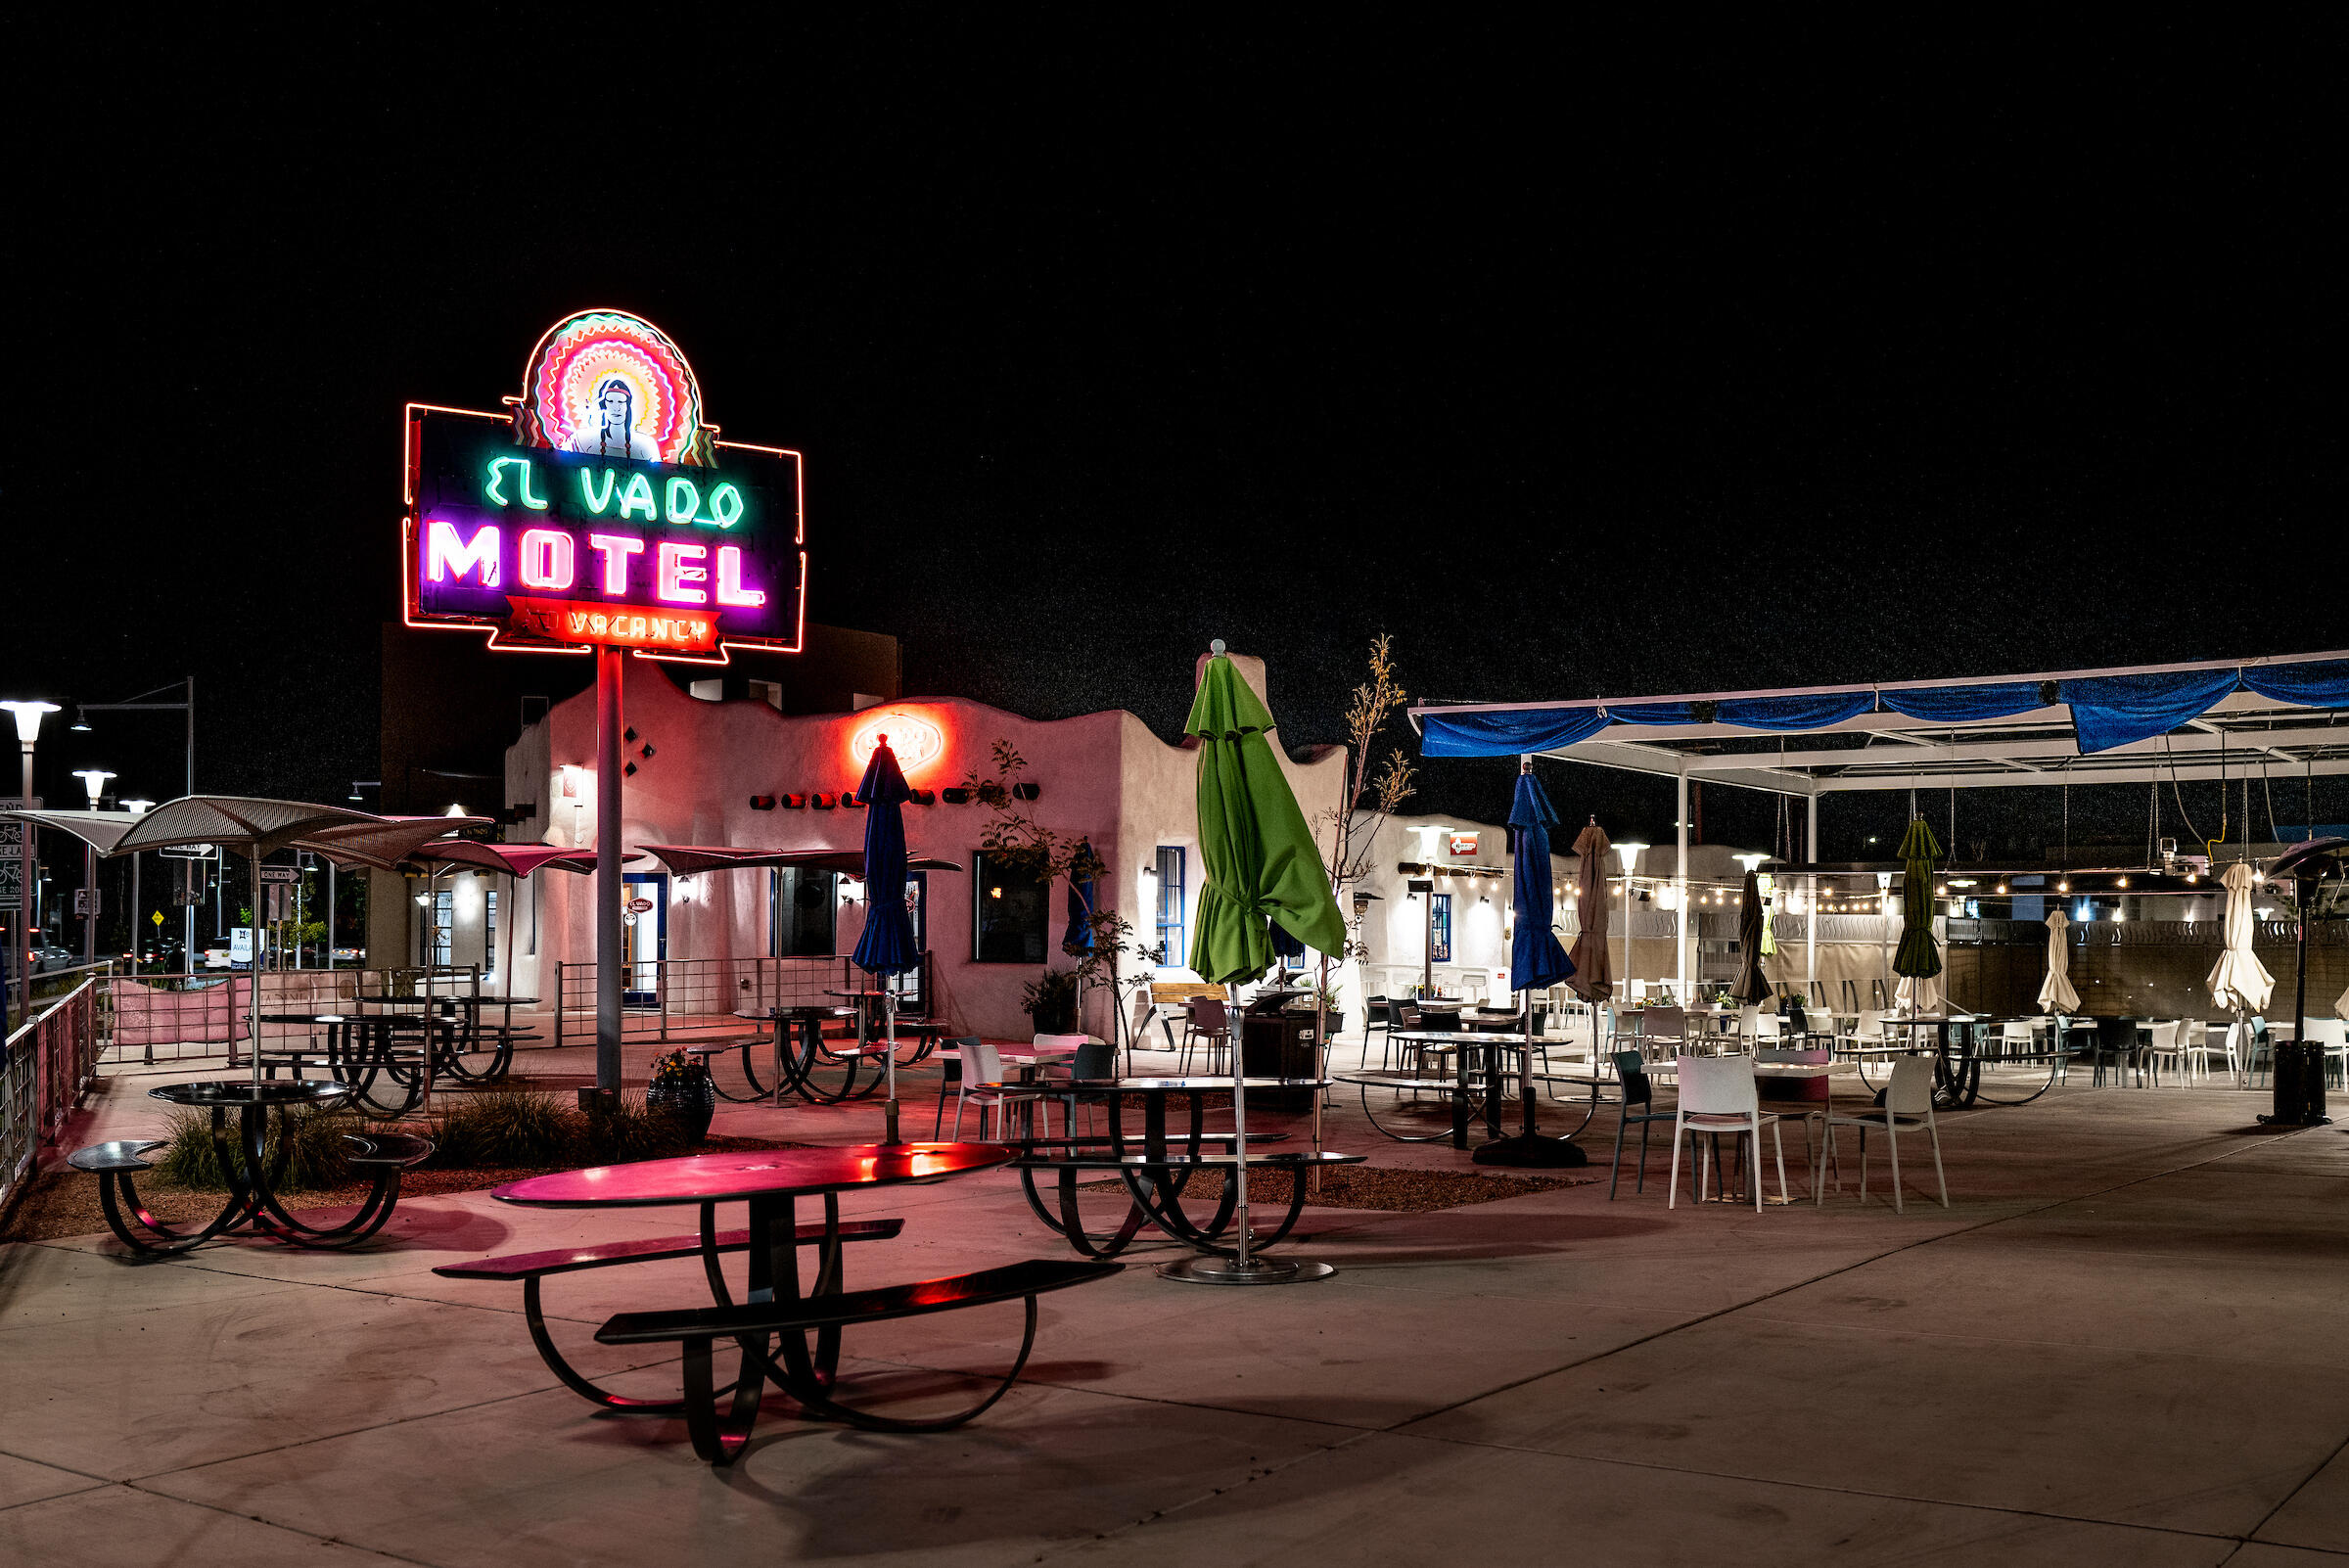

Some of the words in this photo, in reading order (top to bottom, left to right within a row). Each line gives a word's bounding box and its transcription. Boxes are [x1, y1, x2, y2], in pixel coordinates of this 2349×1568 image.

[485, 457, 548, 509] EL
[580, 466, 744, 529] VADO
[426, 521, 765, 607] MOTEL
[568, 612, 707, 642] VACANCY
